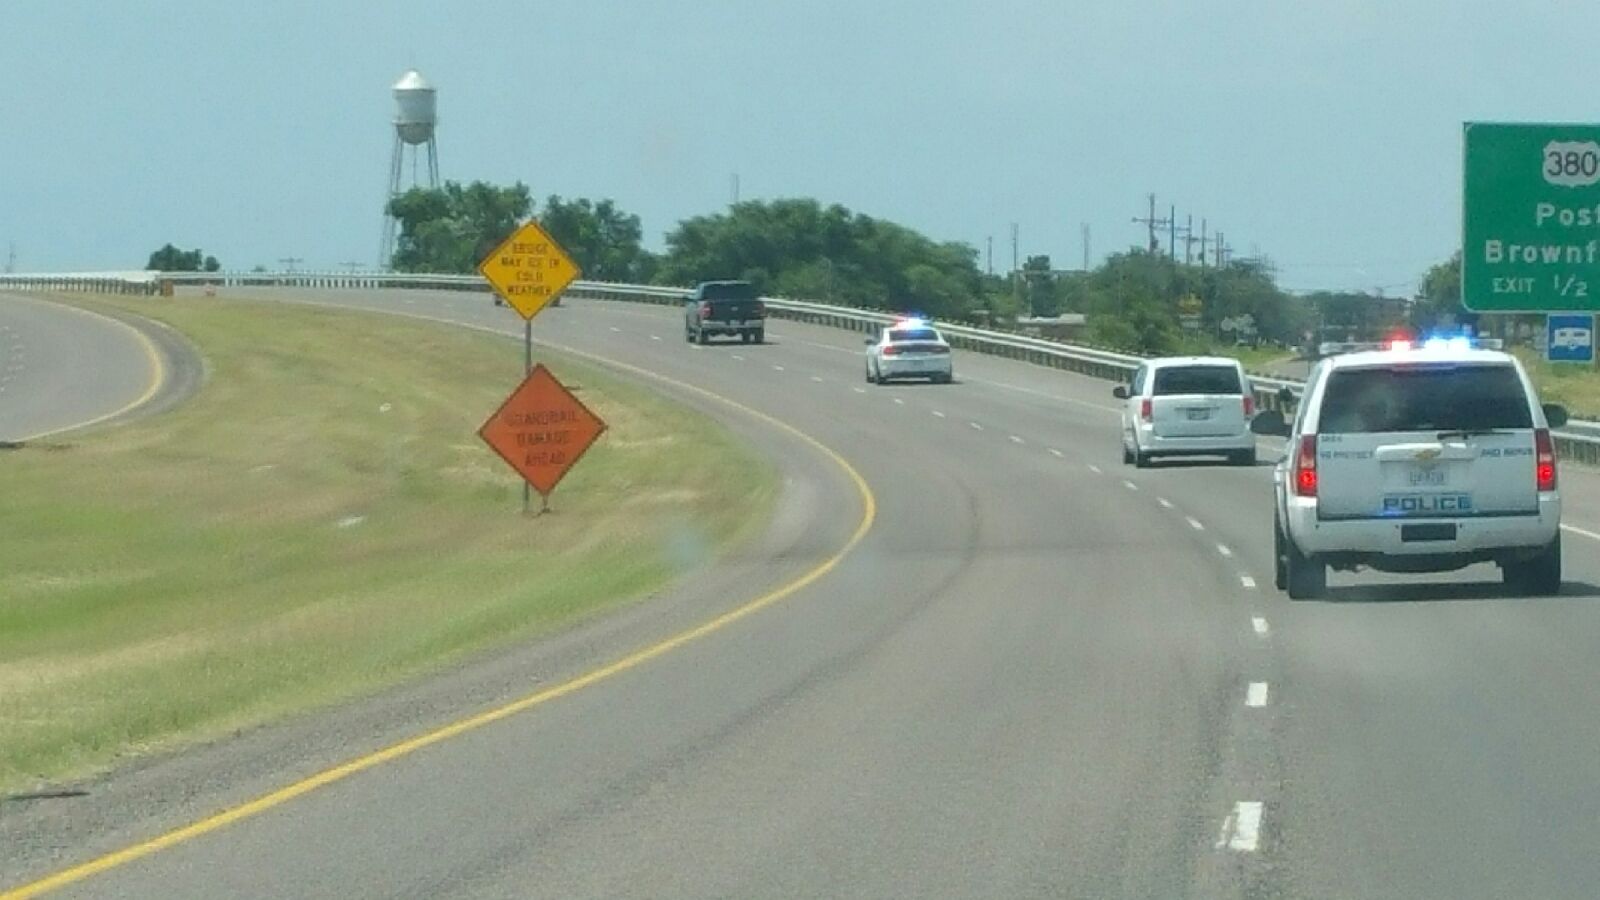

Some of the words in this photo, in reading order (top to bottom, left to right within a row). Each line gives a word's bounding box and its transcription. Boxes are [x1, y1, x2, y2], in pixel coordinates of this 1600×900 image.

[1548, 151, 1597, 177] 380
[501, 256, 521, 267] MAY
[549, 258, 561, 269] IN
[515, 271, 544, 282] COLD
[507, 285, 553, 297] WEATHER
[1492, 277, 1536, 294] EXIT
[1553, 274, 1588, 297] 1/2
[525, 451, 567, 467] AHEAD
[1384, 495, 1472, 511] POLICE
